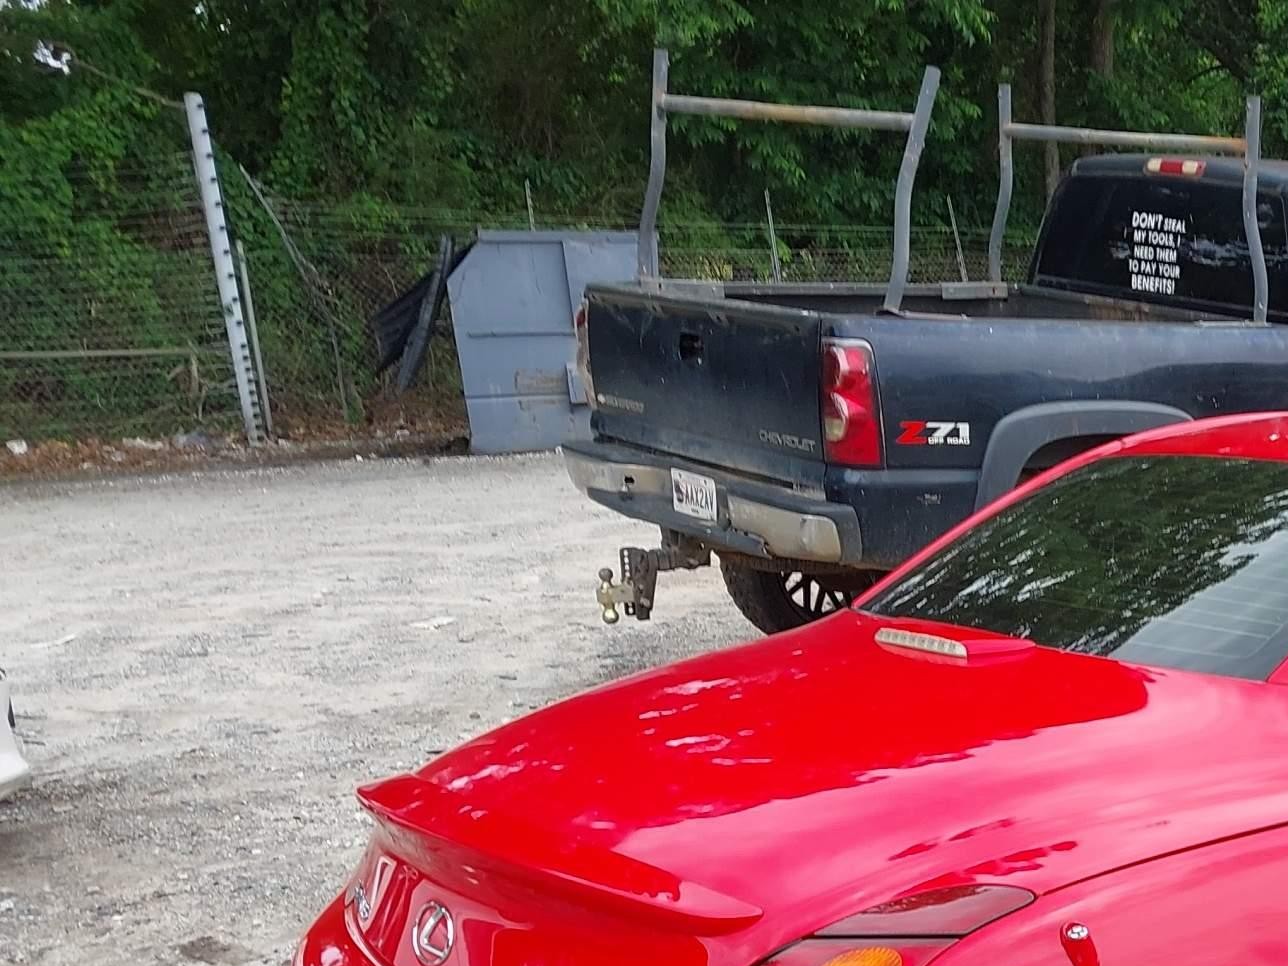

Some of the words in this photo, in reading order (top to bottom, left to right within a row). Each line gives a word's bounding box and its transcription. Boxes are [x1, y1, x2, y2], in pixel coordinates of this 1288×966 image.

[1132, 211, 1163, 230] DON'T
[1163, 217, 1186, 234] STEAL
[1133, 229, 1147, 243] MY
[1148, 230, 1175, 248] TOOLS,
[1177, 234, 1181, 248] I
[1133, 244, 1154, 260] NEED
[1156, 247, 1177, 263] THEM
[1129, 258, 1139, 273] TO
[1140, 260, 1157, 275] PAY
[1158, 263, 1180, 279] YOUR
[1131, 273, 1175, 295] BENEFITS!
[759, 430, 816, 452] CHEVROLET
[895, 421, 970, 444] Z71
